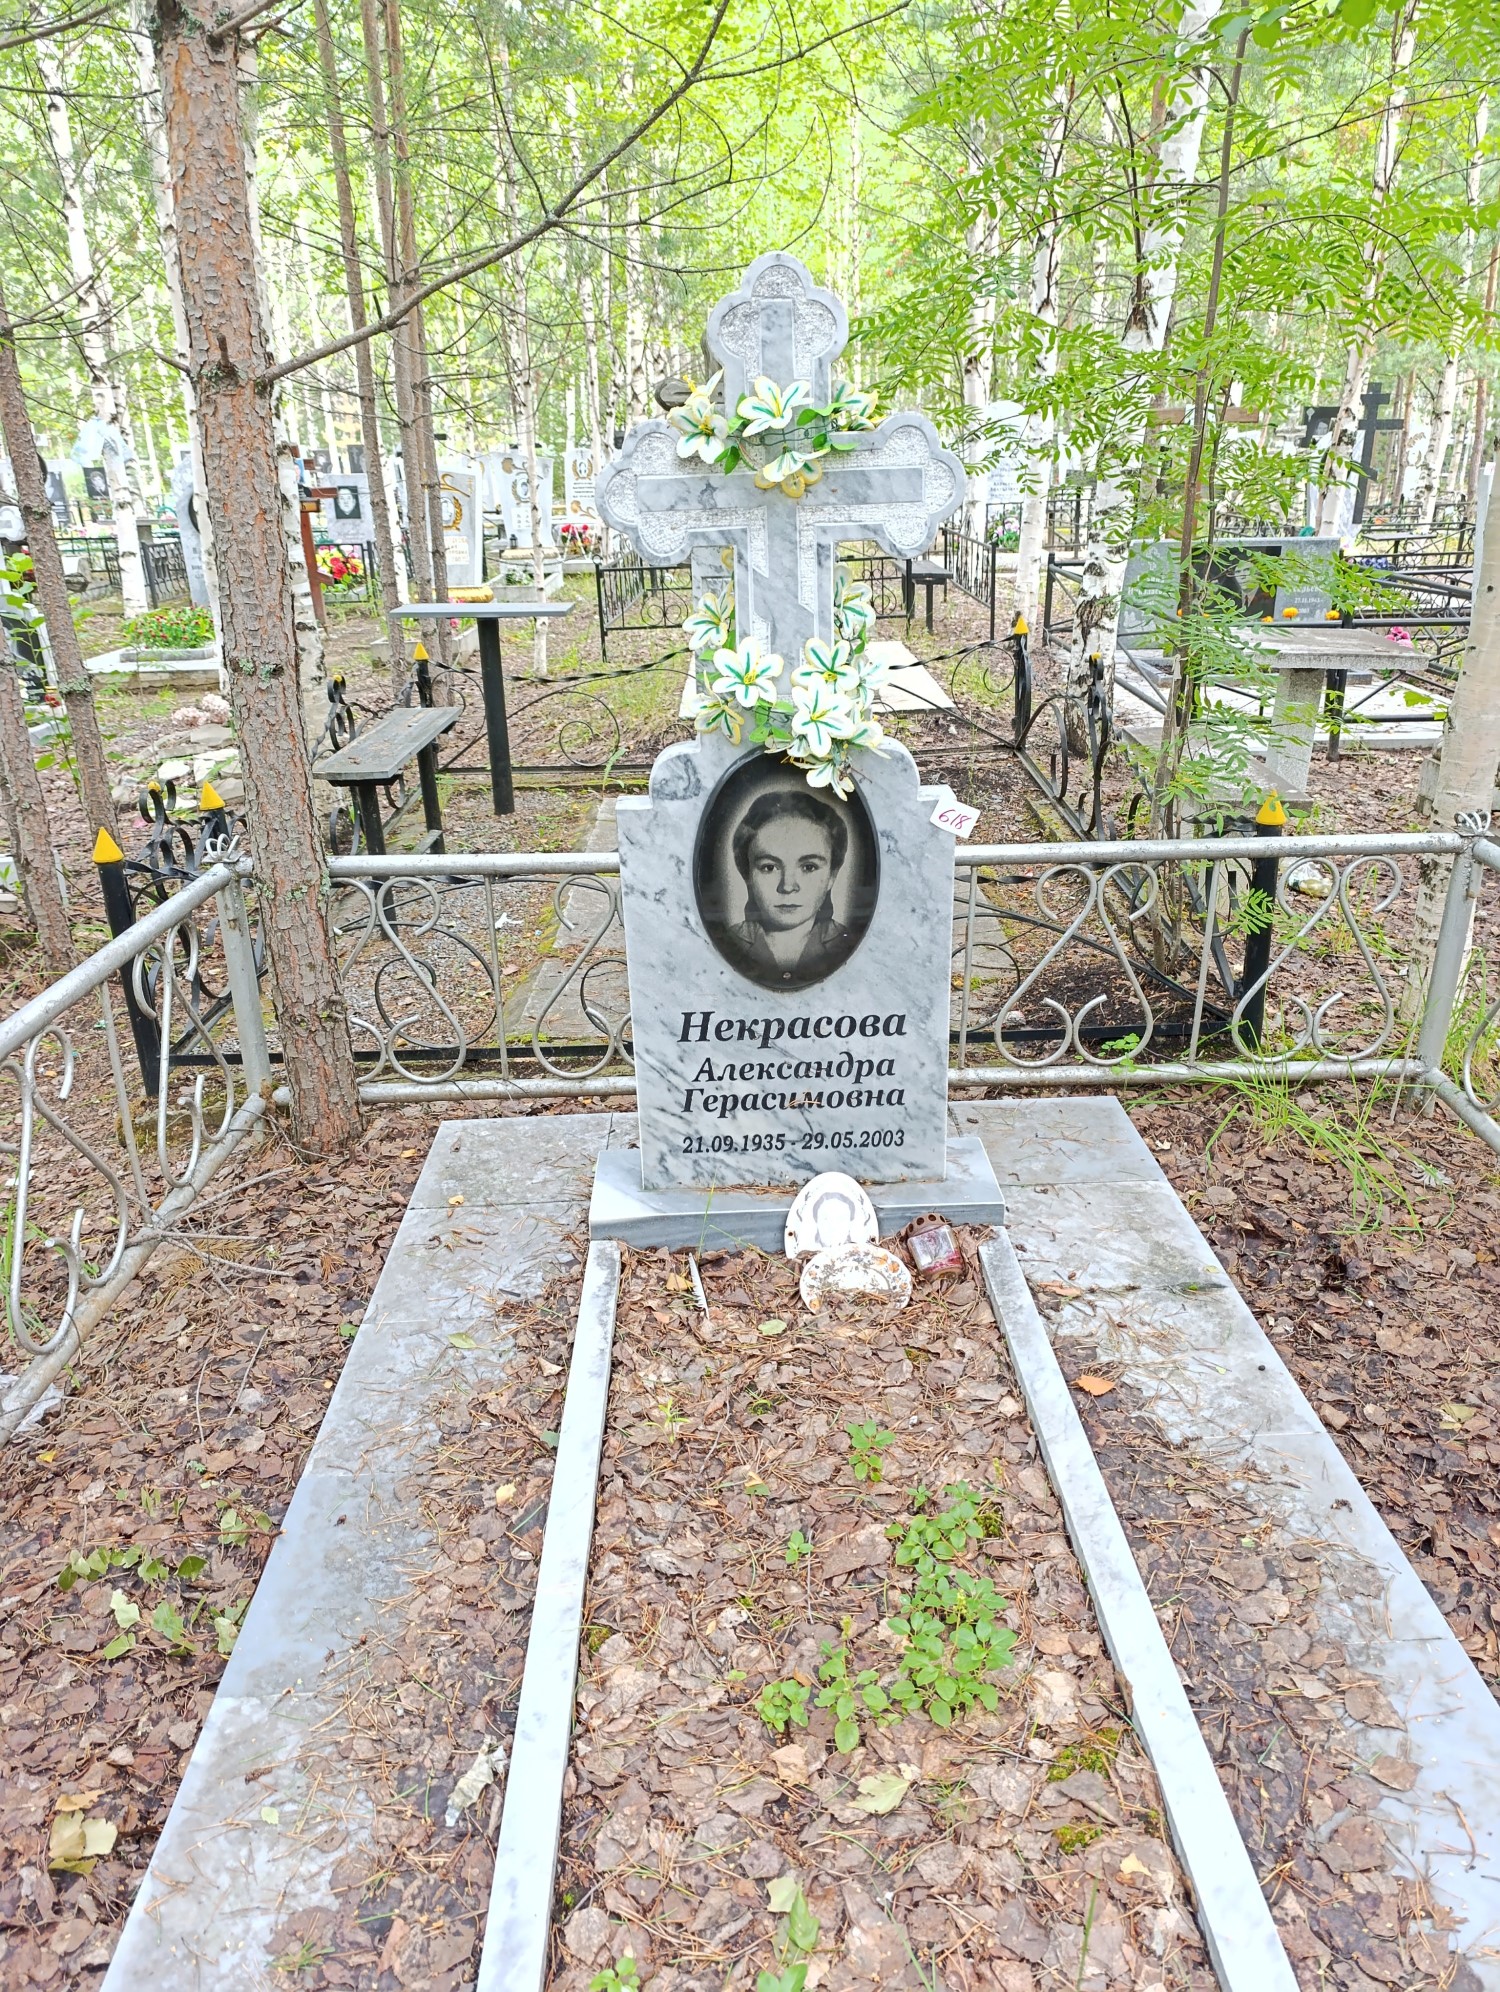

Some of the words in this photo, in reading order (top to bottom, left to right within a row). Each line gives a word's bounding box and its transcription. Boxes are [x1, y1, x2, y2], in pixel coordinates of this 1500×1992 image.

[938, 808, 972, 830] 618
[677, 1011, 907, 1050] Некрасова
[691, 1051, 896, 1084] Александра
[680, 1087, 906, 1119] Герасимовна
[682, 1133, 786, 1154] 21.09.1935
[801, 1129, 905, 1150] 29.05.2003
